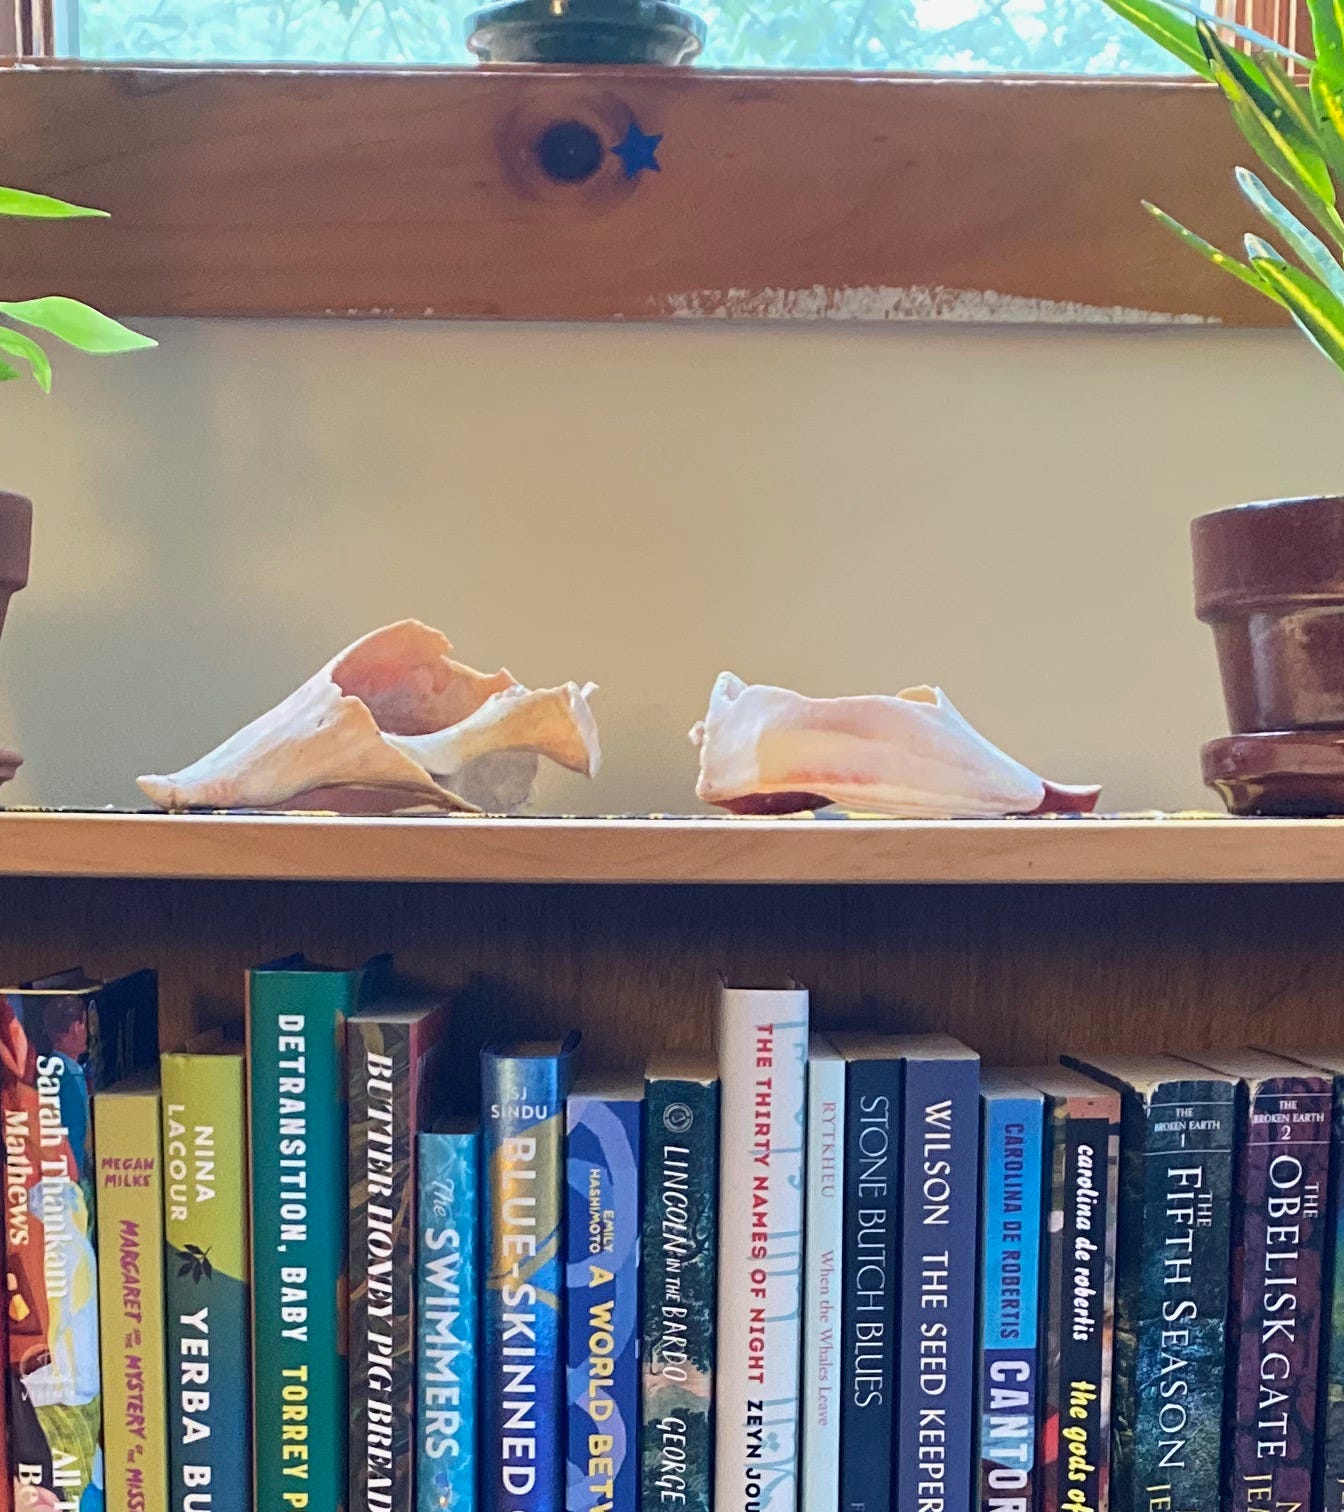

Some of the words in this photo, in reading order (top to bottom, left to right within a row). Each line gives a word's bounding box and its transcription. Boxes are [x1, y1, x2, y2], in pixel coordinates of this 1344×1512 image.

[755, 1023, 775, 1068] THE
[168, 1104, 188, 1222] LACOUR
[194, 1125, 214, 1204] NINA
[276, 1013, 308, 1253] DETRANSITION,
[366, 1052, 393, 1197] BUTTER
[753, 1077, 773, 1168] THIRTY
[857, 1095, 889, 1202] STONE
[922, 1099, 953, 1226] WILSON
[661, 1145, 690, 1253] LINCOLN
[750, 1177, 770, 1260] NAMES
[1163, 1166, 1203, 1285] FIFTH
[367, 1202, 393, 1327] HONEY
[588, 1266, 614, 1288] A
[750, 1269, 767, 1300] OF
[855, 1210, 885, 1313] BUTCH
[921, 1251, 949, 1309] THE
[1261, 1155, 1303, 1344] OBELISK
[280, 1265, 308, 1344] BABY
[424, 1228, 460, 1459] SWIMMERS
[500, 1135, 538, 1496] BLUE-SKINNED
[659, 1306, 689, 1383] BARDO
[747, 1310, 767, 1386] NIGHT
[178, 1307, 212, 1446] YERBA
[367, 1328, 392, 1393] PIG
[587, 1300, 613, 1422] WORLD
[852, 1321, 883, 1408] BLUES
[920, 1323, 947, 1395] SEED
[1068, 1379, 1096, 1419] the
[1157, 1300, 1197, 1470] SEASON
[1256, 1352, 1291, 1458] GATE
[281, 1365, 309, 1480] TORREY
[655, 1418, 689, 1505] GEORGE
[745, 1401, 763, 1458] ZEYN
[1062, 1426, 1095, 1483] gods
